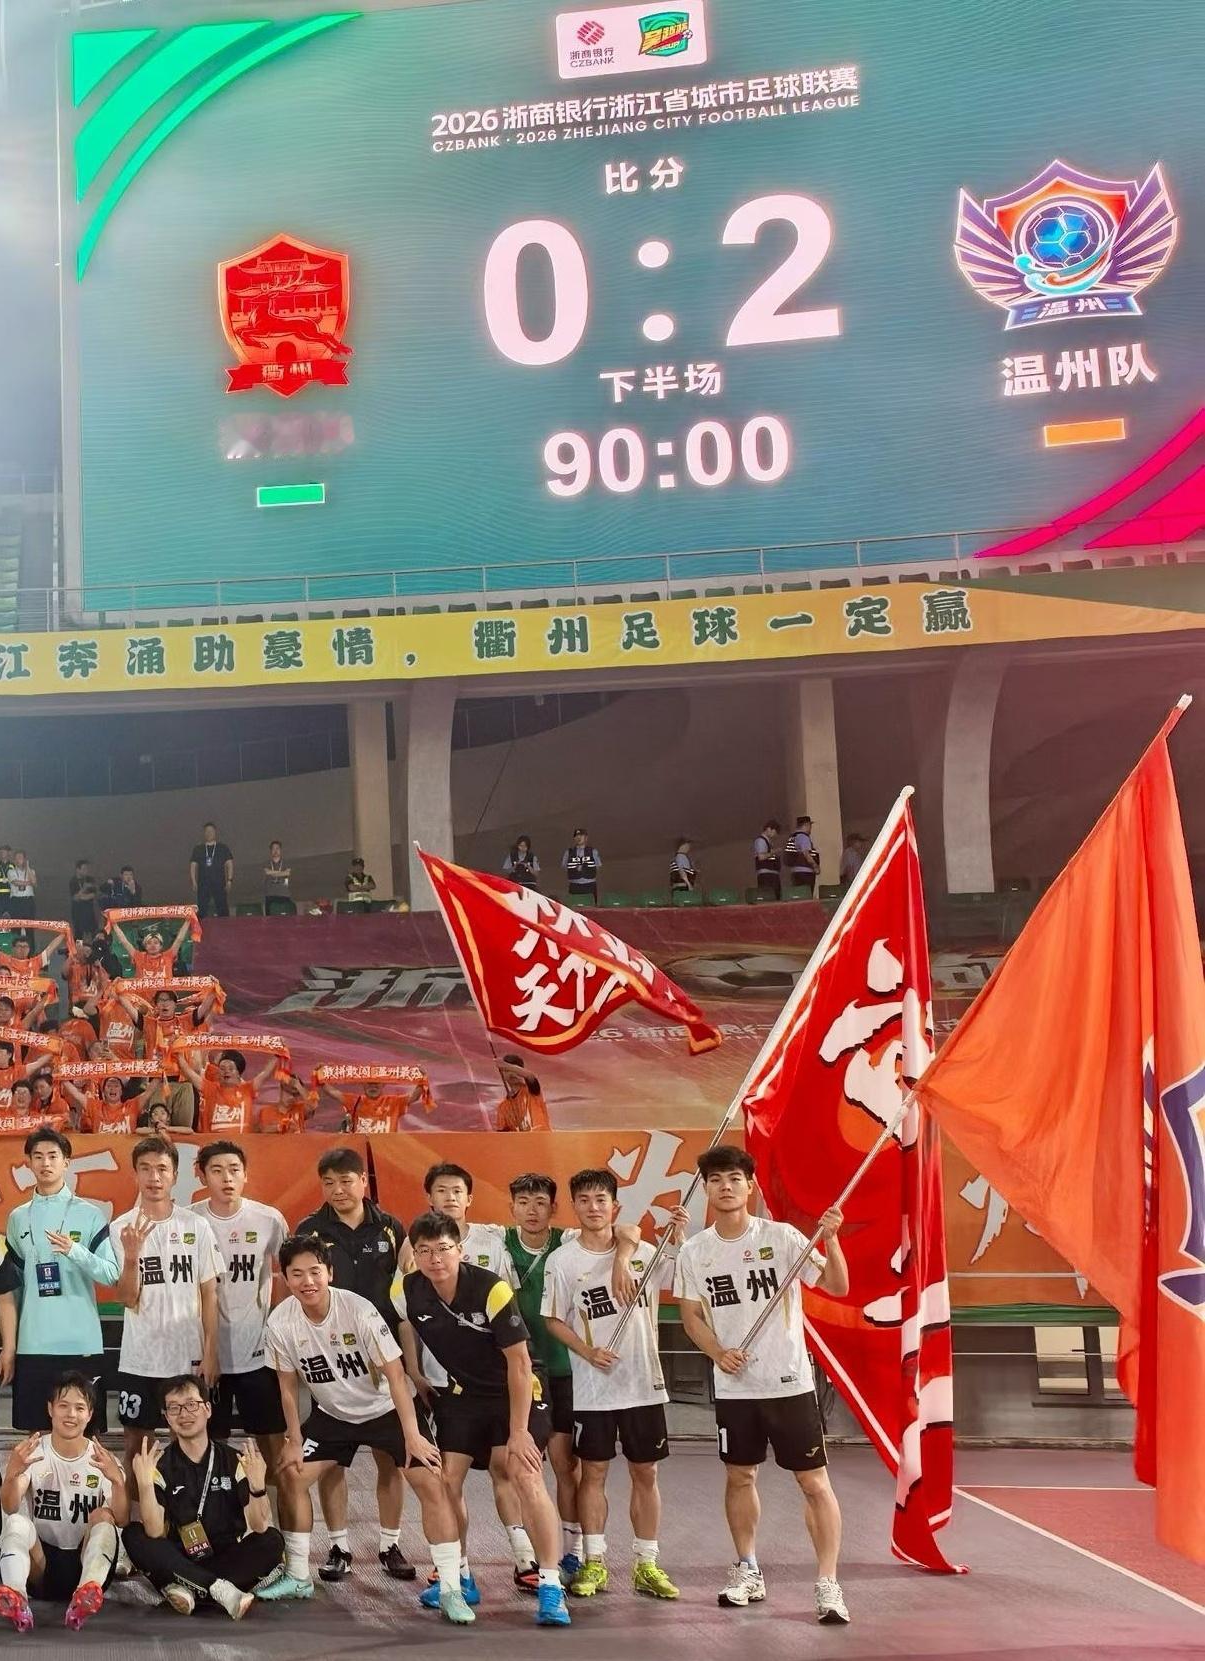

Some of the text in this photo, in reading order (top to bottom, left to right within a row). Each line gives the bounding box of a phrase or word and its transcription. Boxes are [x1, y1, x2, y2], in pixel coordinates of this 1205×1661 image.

[570, 47, 614, 60] 浙商银行
[570, 57, 614, 68] CZBANK
[432, 66, 859, 137] 2026 浙商银行浙江省城市足球联赛
[432, 93, 861, 154] CZBANK 2026 ZHEJIANG CITY FOOTBALL LEAGUE
[604, 156, 685, 196] 比分
[483, 218, 590, 366] 0
[722, 193, 841, 348] 2
[1037, 295, 1107, 316] 温州
[600, 362, 722, 404] 下半场
[1001, 343, 1158, 397] 温州队
[542, 414, 790, 498] 90:00
[323, 1065, 424, 1080] 敢拼敢闯 温州最强
[216, 1253, 256, 1283] 州
[705, 1267, 781, 1309] 温州
[299, 1350, 369, 1385] 温州
[119, 1391, 142, 1419] 33
[34, 1489, 105, 1524] 温州
